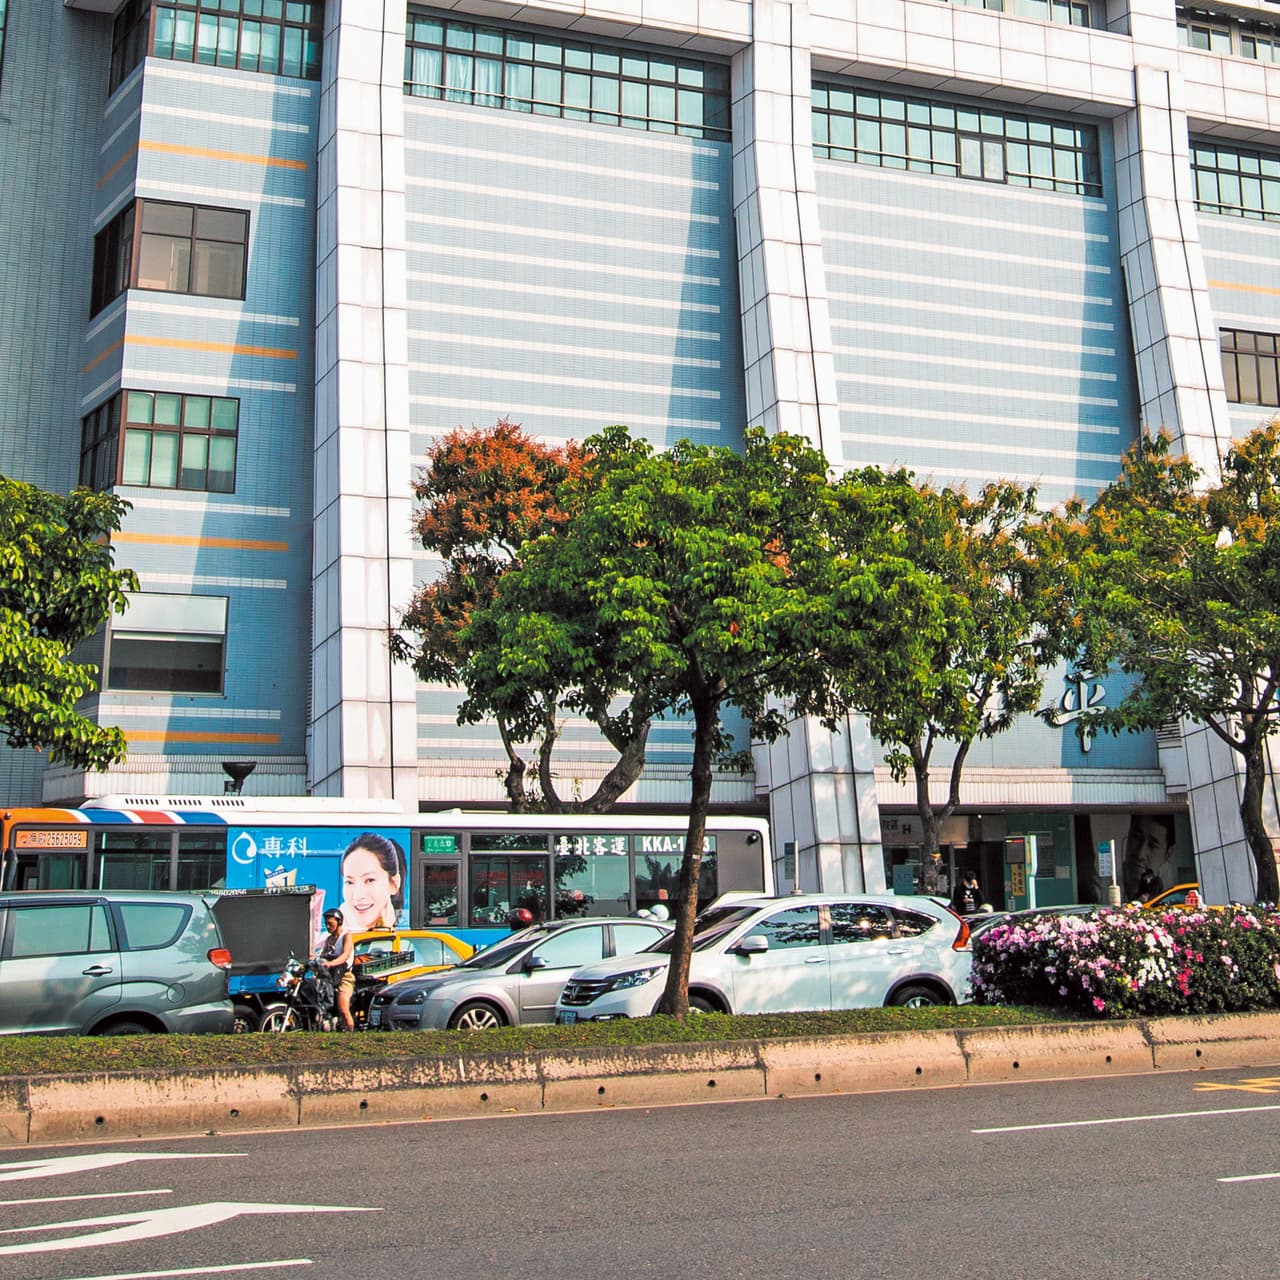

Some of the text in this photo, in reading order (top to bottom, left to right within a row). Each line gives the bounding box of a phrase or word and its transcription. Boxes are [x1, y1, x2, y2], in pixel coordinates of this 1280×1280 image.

[555, 836, 627, 856] 臺北客運
[642, 835, 711, 852] KKA-13
